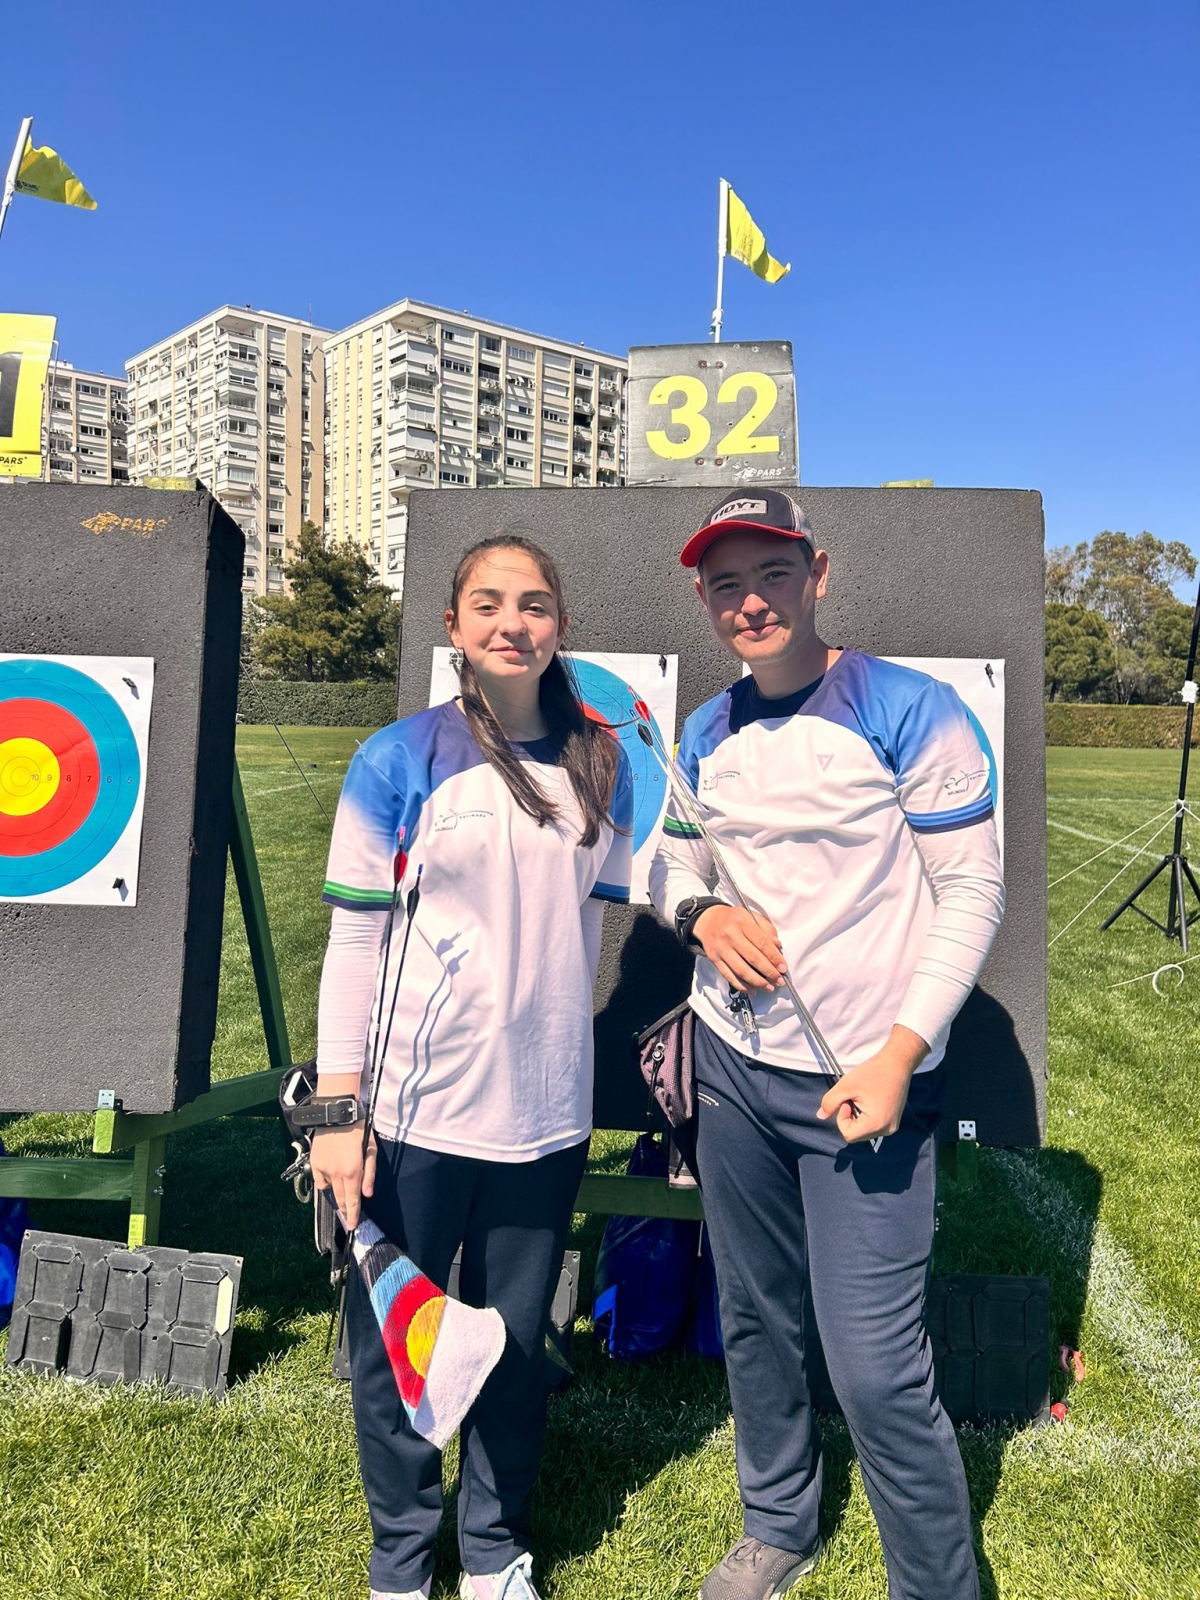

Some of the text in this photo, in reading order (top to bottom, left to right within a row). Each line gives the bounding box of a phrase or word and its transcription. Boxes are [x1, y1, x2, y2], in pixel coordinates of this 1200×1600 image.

[645, 371, 780, 460] 32
[756, 468, 782, 477] PARS
[713, 501, 761, 521] HOYT
[653, 774, 659, 782] 5
